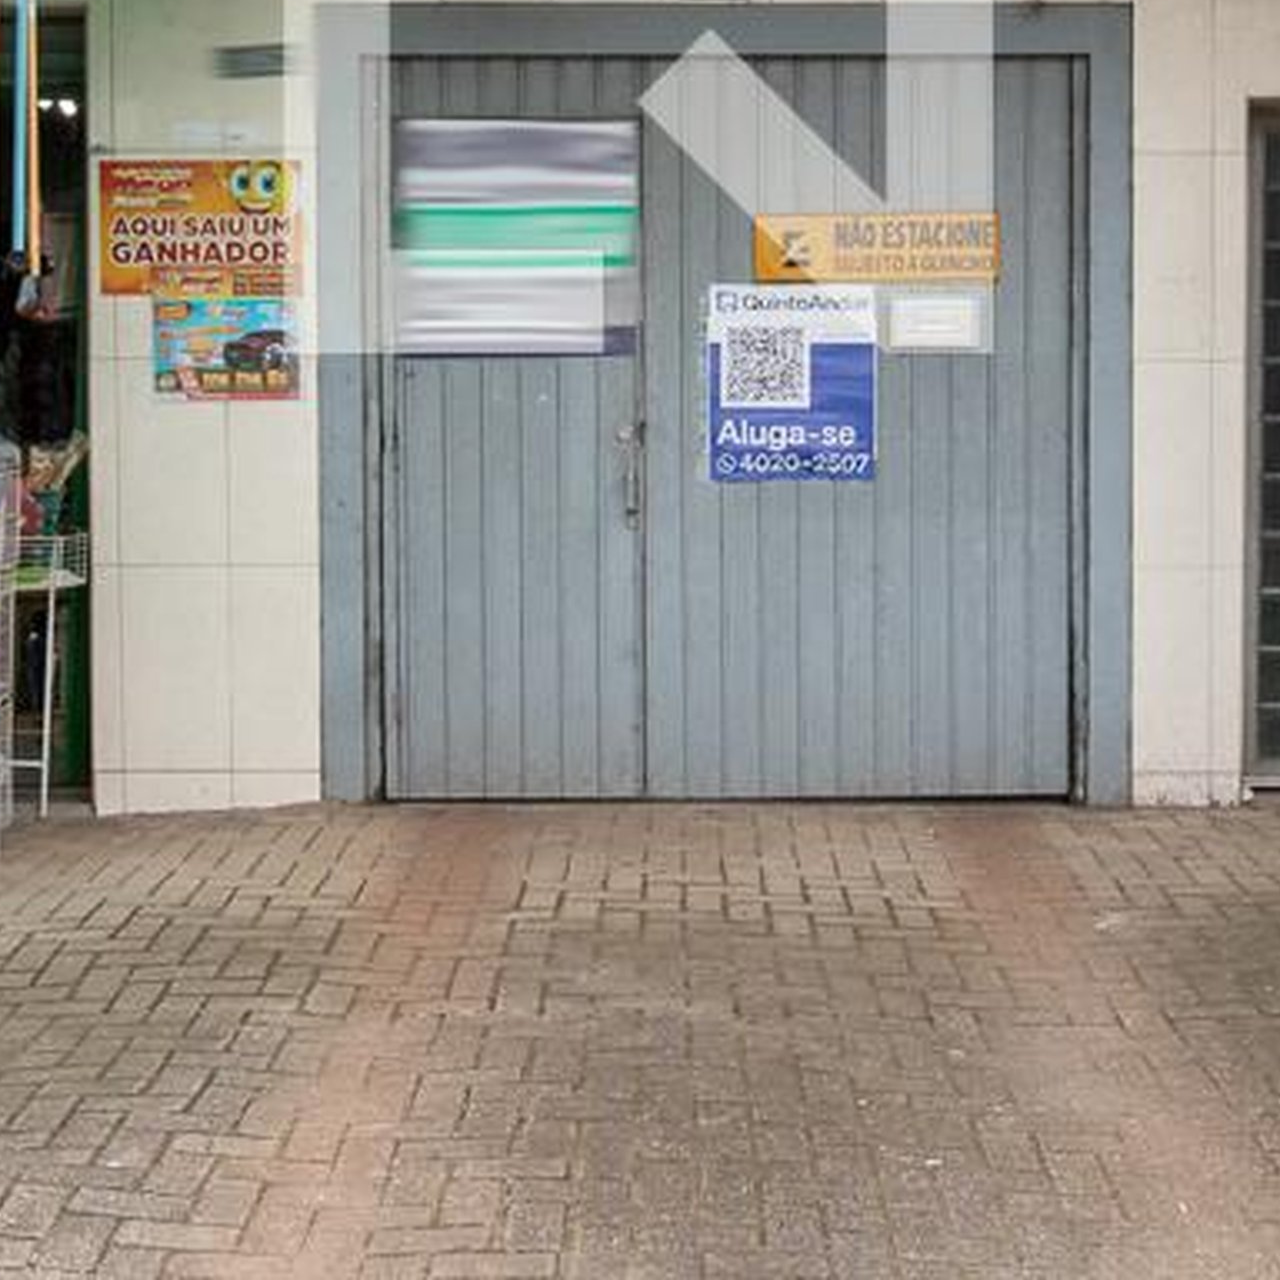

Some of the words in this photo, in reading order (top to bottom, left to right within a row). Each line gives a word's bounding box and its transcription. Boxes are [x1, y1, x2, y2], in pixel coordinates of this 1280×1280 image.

[112, 217, 175, 237] AQUI
[183, 217, 246, 236] SAIU
[882, 219, 994, 249] ESTACIONE
[111, 240, 292, 265] GANHADOR
[716, 419, 857, 451] Aluga-se
[740, 453, 870, 474] 4020-2507
